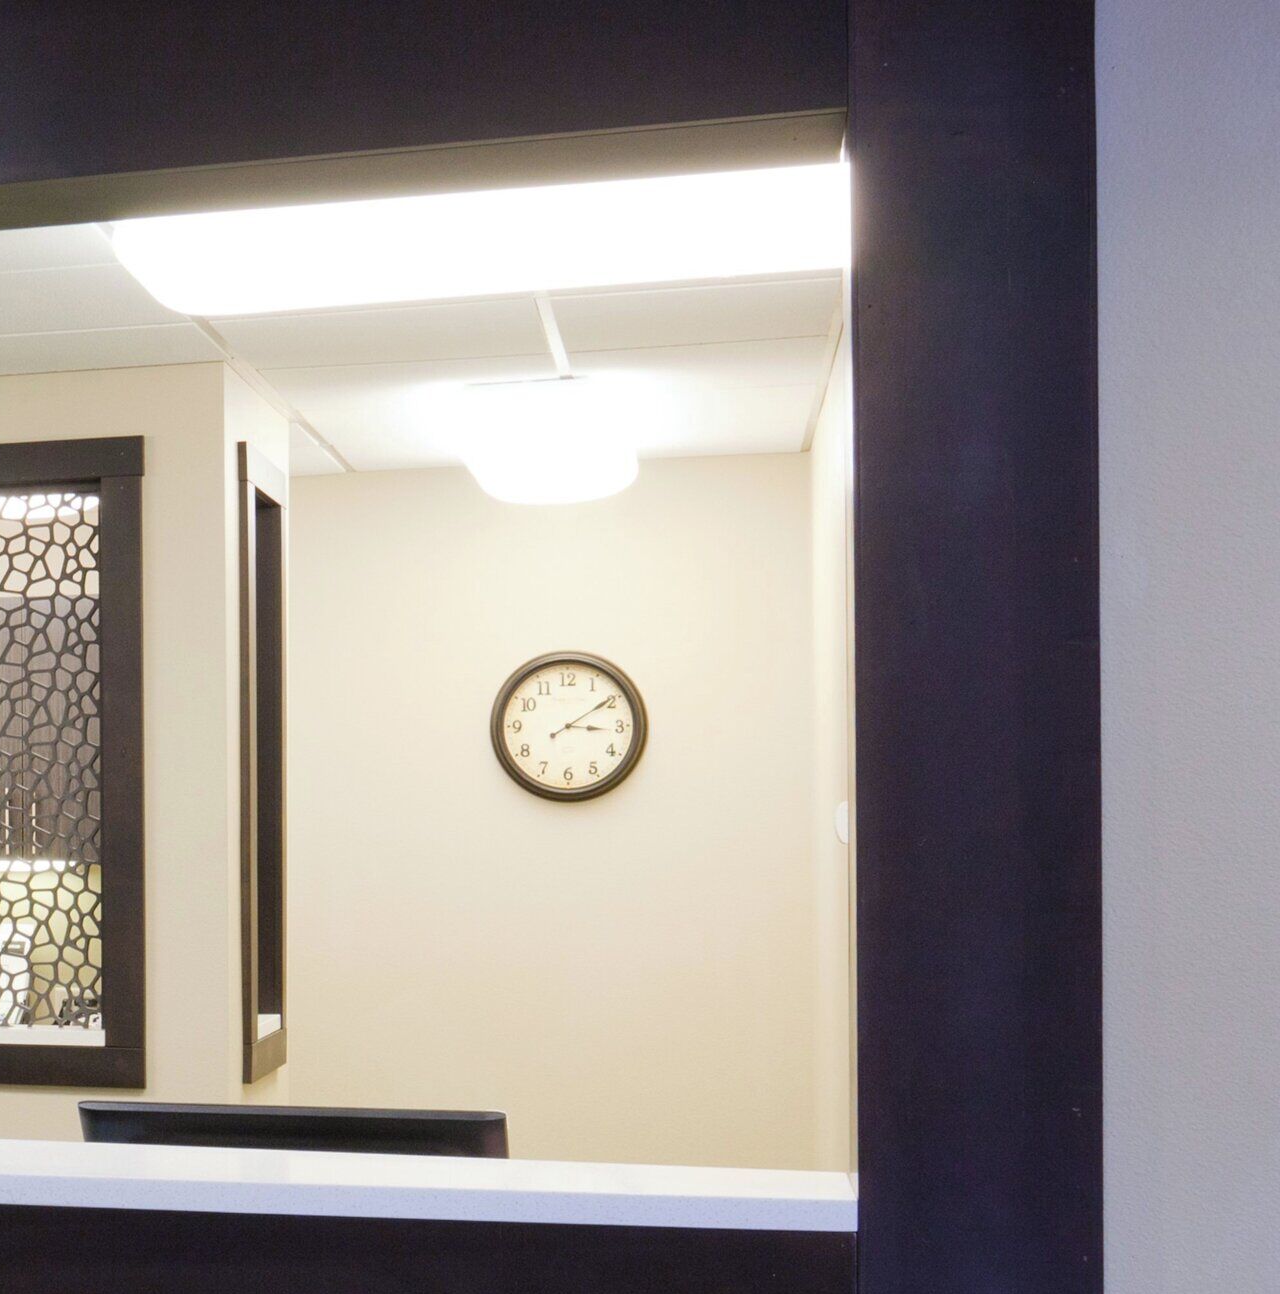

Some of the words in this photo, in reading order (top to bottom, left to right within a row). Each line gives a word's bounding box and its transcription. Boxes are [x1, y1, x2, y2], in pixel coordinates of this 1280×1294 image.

[559, 672, 576, 686] 12
[589, 677, 595, 692] 1
[537, 681, 551, 695] 11
[521, 697, 536, 712] 10
[606, 695, 616, 709] 2
[512, 720, 522, 733] 9
[615, 720, 625, 733] 3
[520, 743, 530, 757] 8
[605, 743, 616, 757] 4
[539, 761, 548, 775] 7
[563, 767, 573, 780] 6
[588, 761, 598, 775] 5
